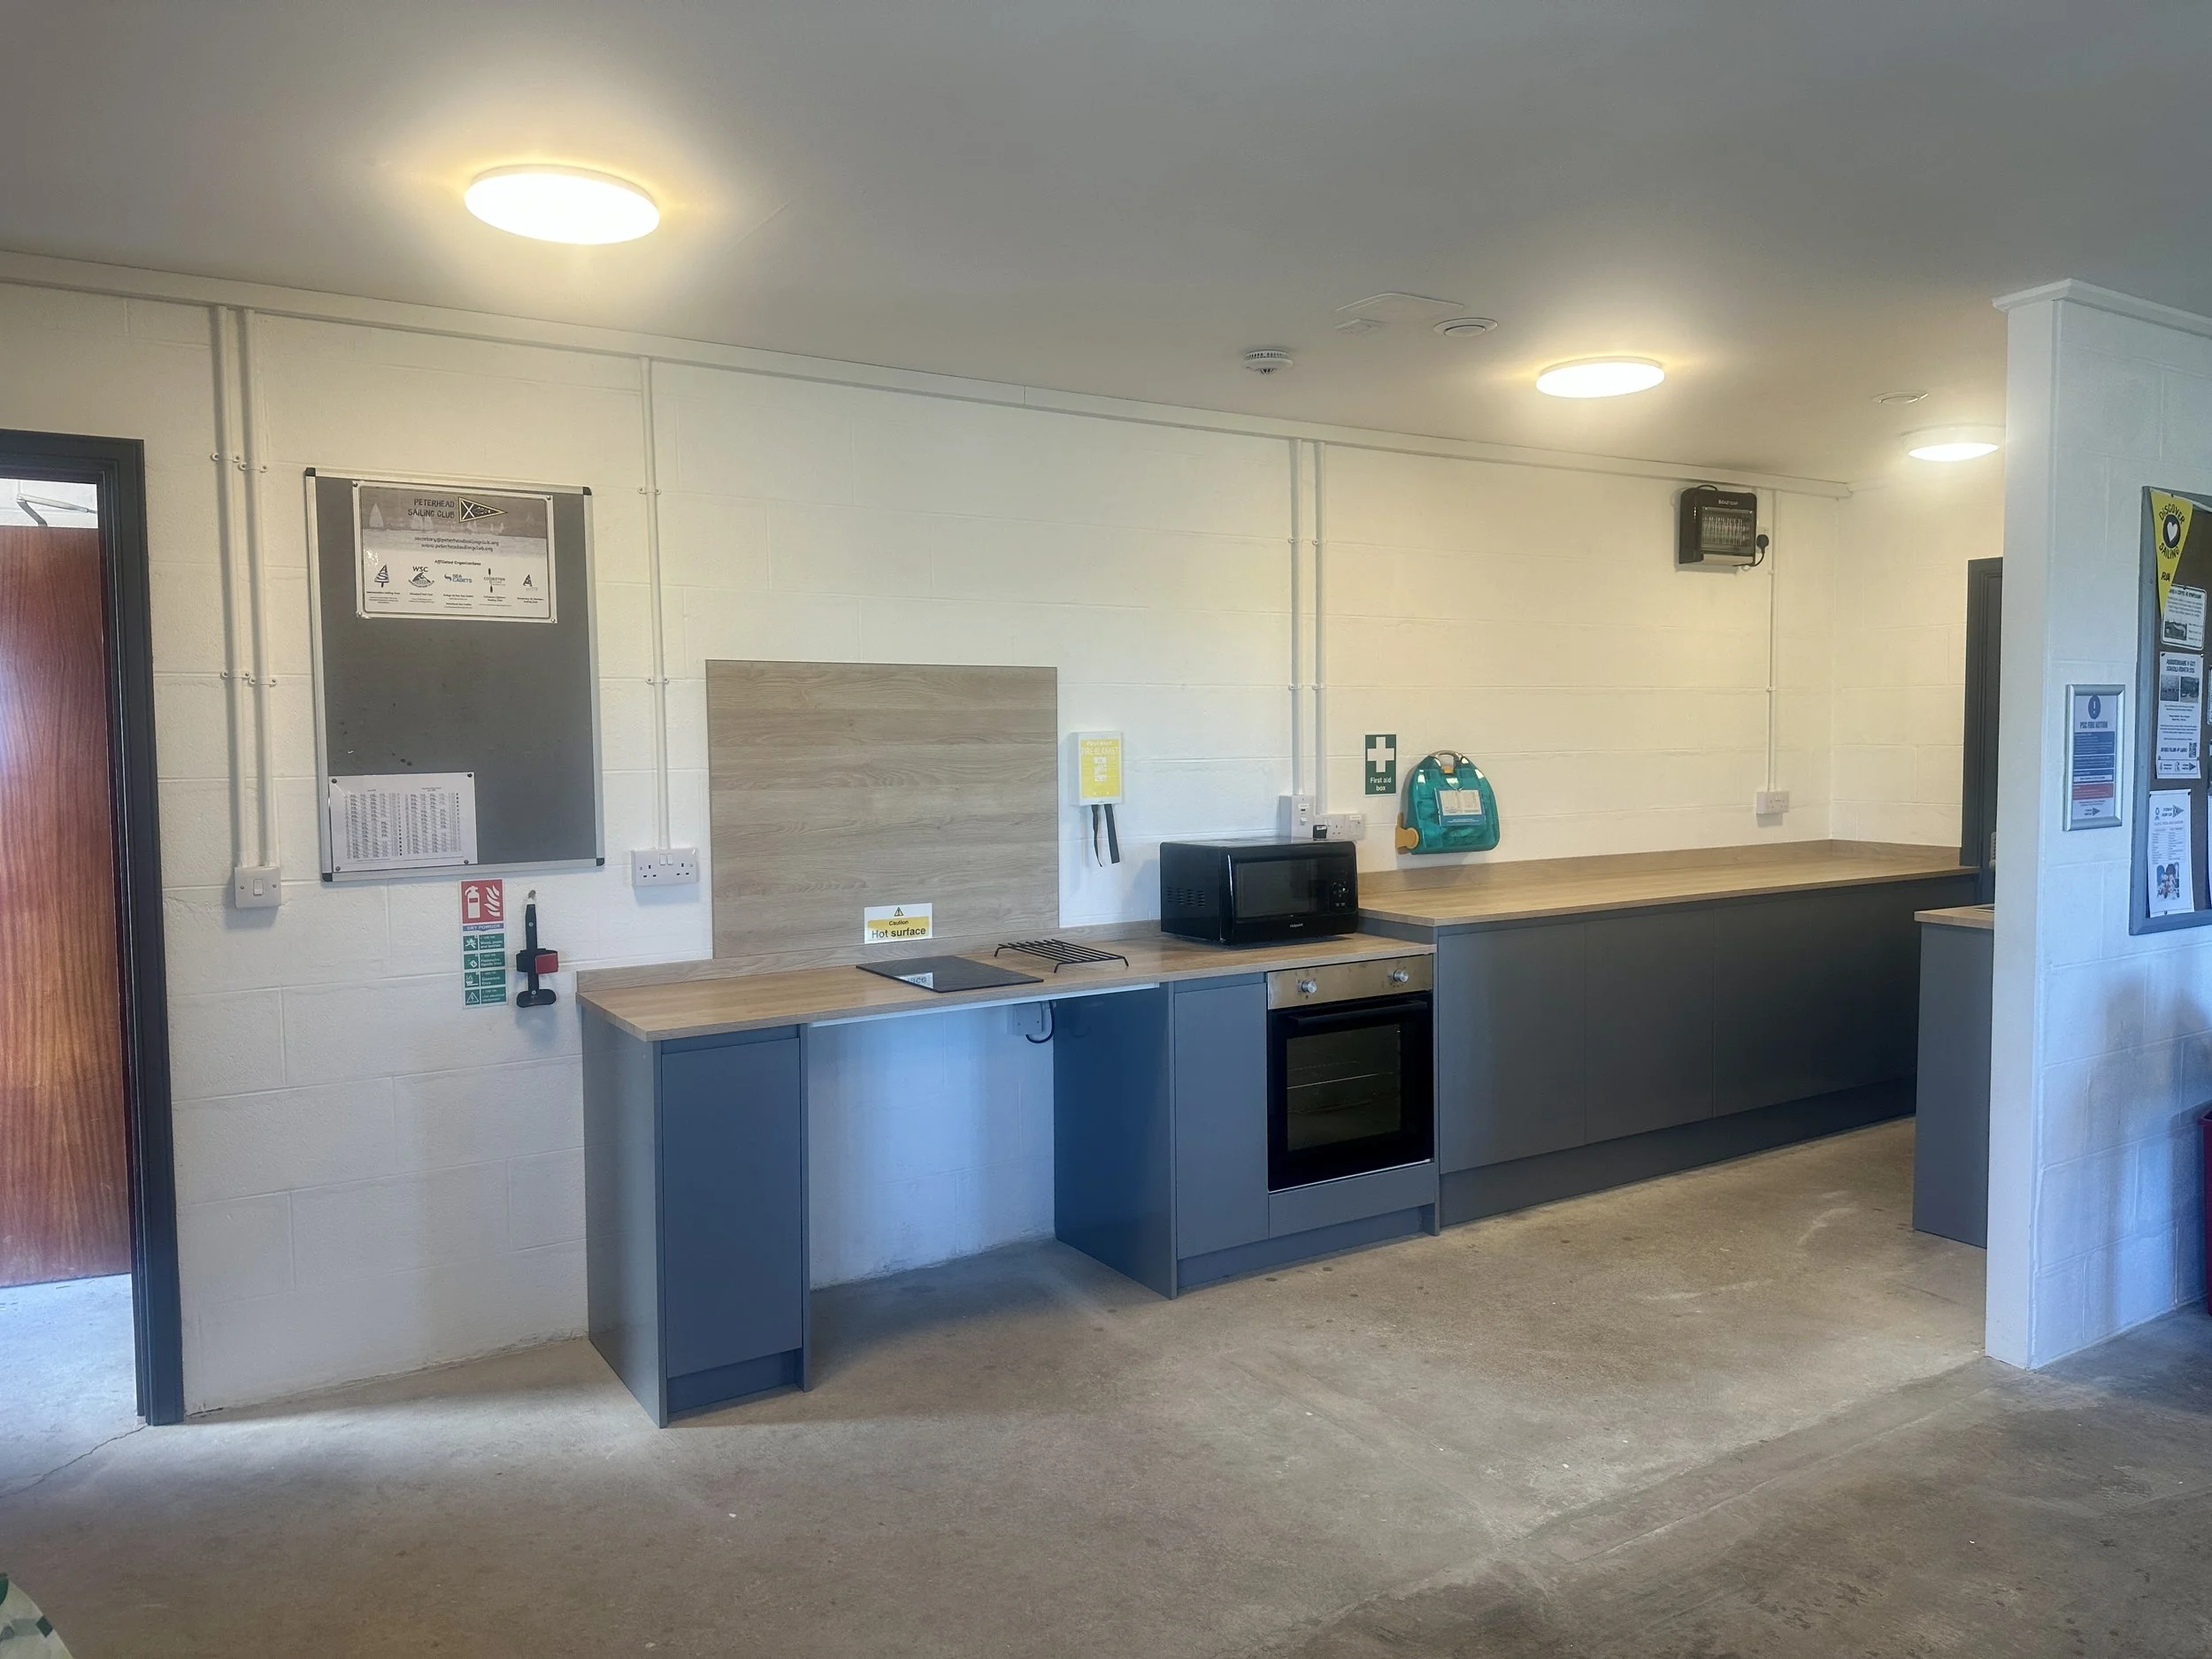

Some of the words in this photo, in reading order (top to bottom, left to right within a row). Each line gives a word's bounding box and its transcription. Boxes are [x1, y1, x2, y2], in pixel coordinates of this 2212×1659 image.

[414, 498, 455, 508] PETERHEAD
[408, 508, 435, 517] SAILING
[2158, 503, 2185, 525] DISCOVER
[2159, 541, 2180, 559] SAILING
[872, 930, 888, 939] Hot
[890, 927, 926, 938] surface
